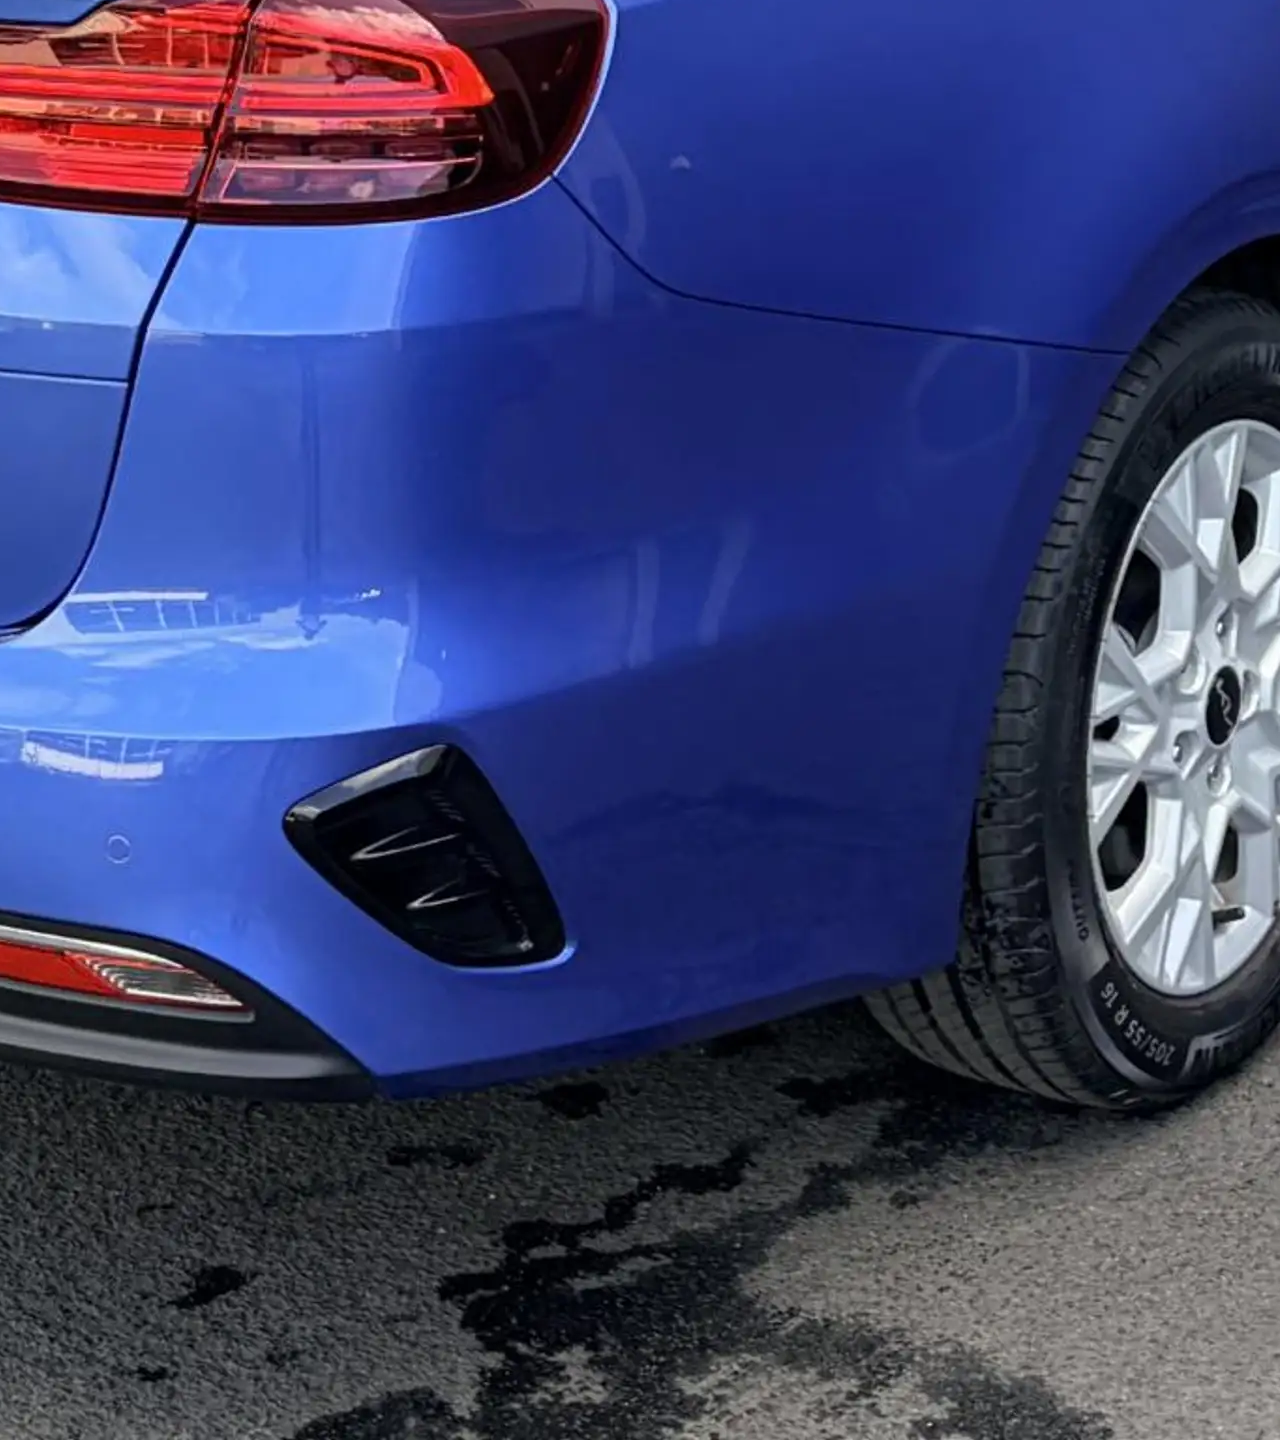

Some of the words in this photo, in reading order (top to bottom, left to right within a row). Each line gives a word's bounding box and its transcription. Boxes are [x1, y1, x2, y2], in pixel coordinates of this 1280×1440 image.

[1100, 981, 1119, 1009] 16
[1114, 1004, 1130, 1026] R
[1124, 1019, 1177, 1067] 205/55
